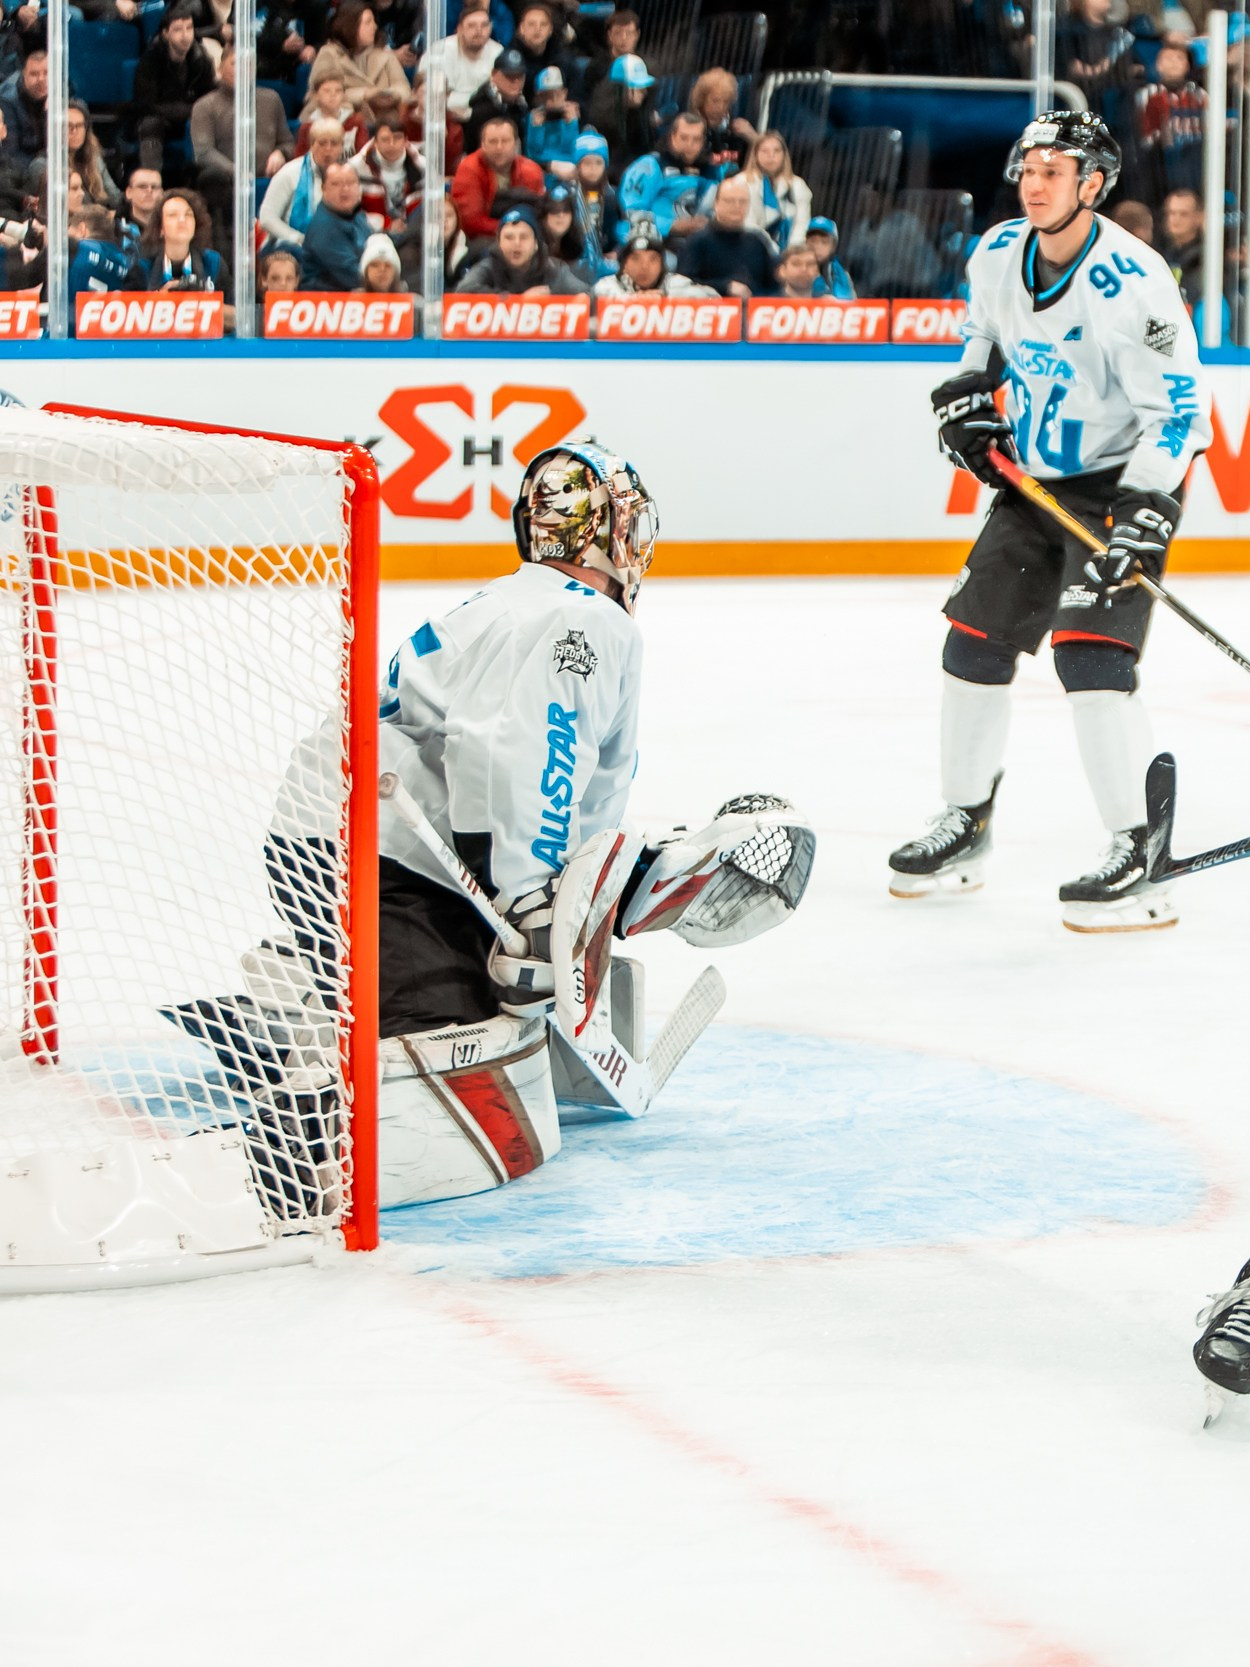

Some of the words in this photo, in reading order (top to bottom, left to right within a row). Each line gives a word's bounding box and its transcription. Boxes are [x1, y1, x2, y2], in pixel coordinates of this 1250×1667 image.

[1088, 251, 1148, 299] 94
[79, 300, 222, 332] FONBET
[267, 299, 407, 334] FONBET
[444, 301, 587, 336] FONBET
[602, 304, 739, 338] FONBET
[749, 305, 887, 339] FONBET
[1062, 326, 1083, 341] A
[935, 391, 995, 424] CCM
